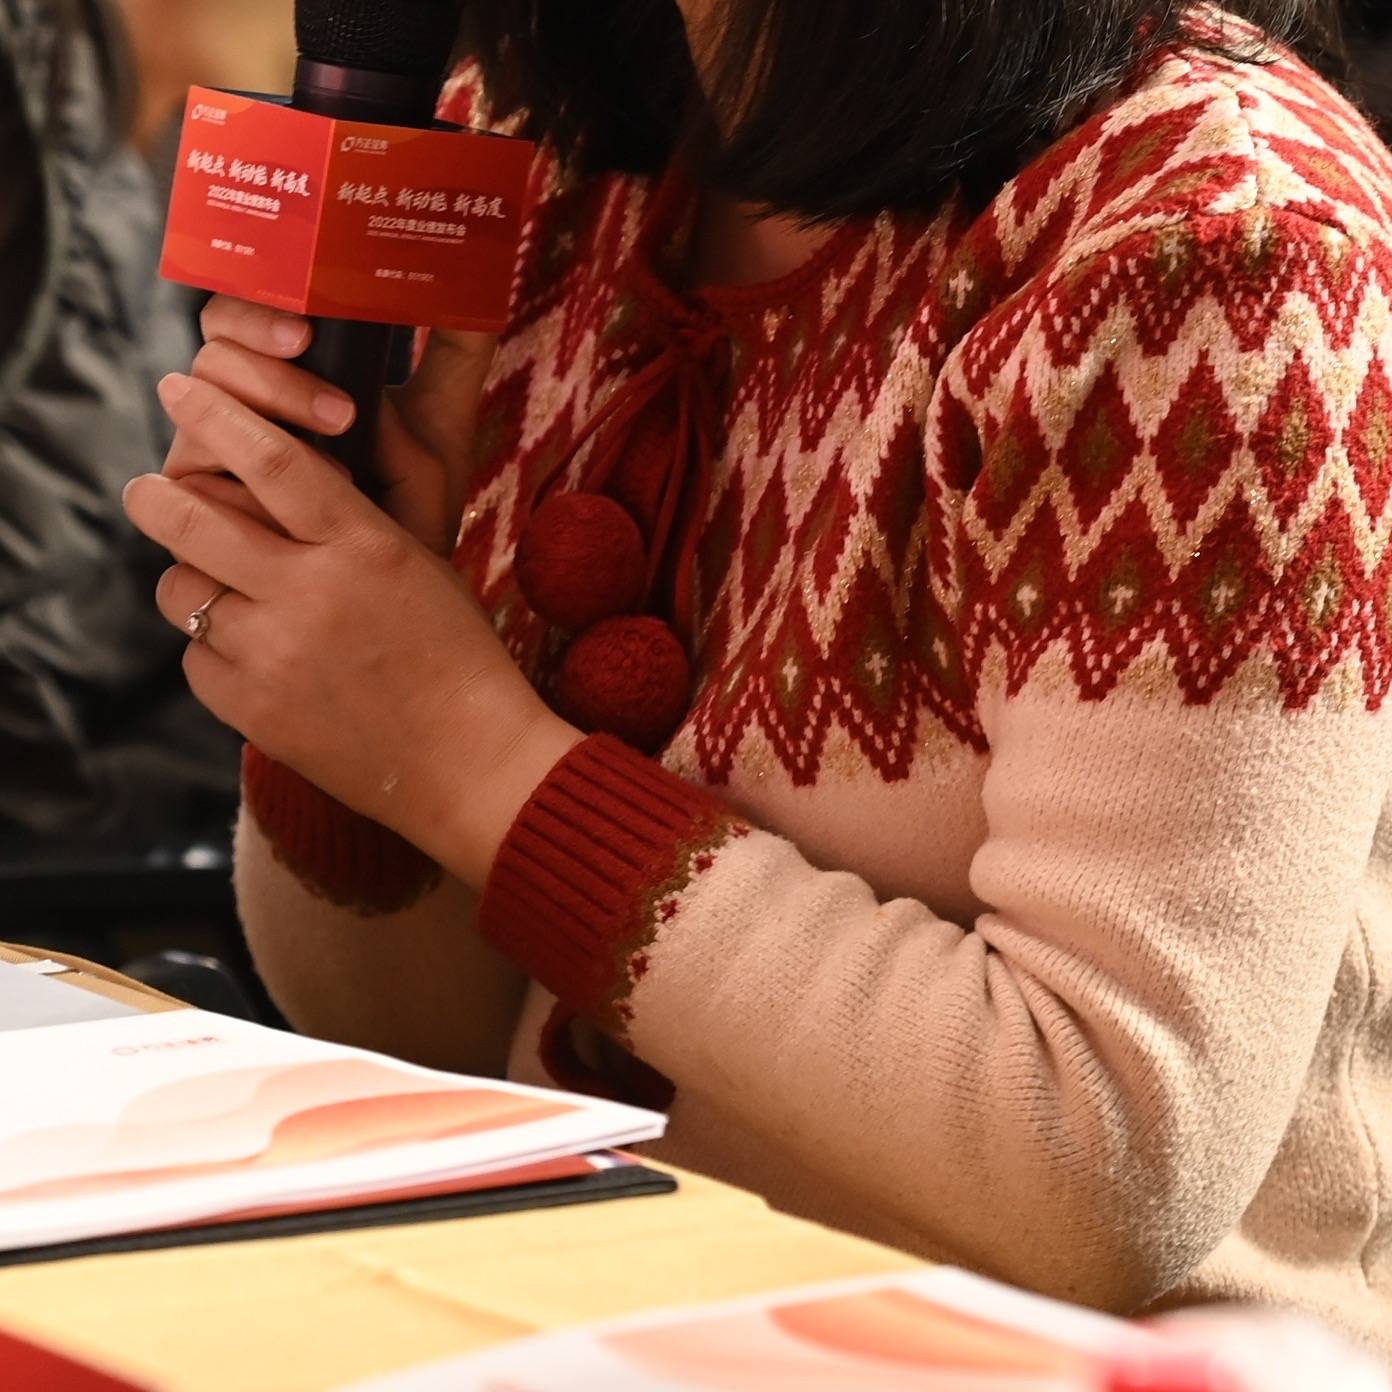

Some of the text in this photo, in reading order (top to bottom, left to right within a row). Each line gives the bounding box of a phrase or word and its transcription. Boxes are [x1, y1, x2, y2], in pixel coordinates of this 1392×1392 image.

[187, 149, 226, 178] 新起点
[270, 167, 310, 197] 新高度
[337, 181, 506, 218] 新起点 新动能 新高度
